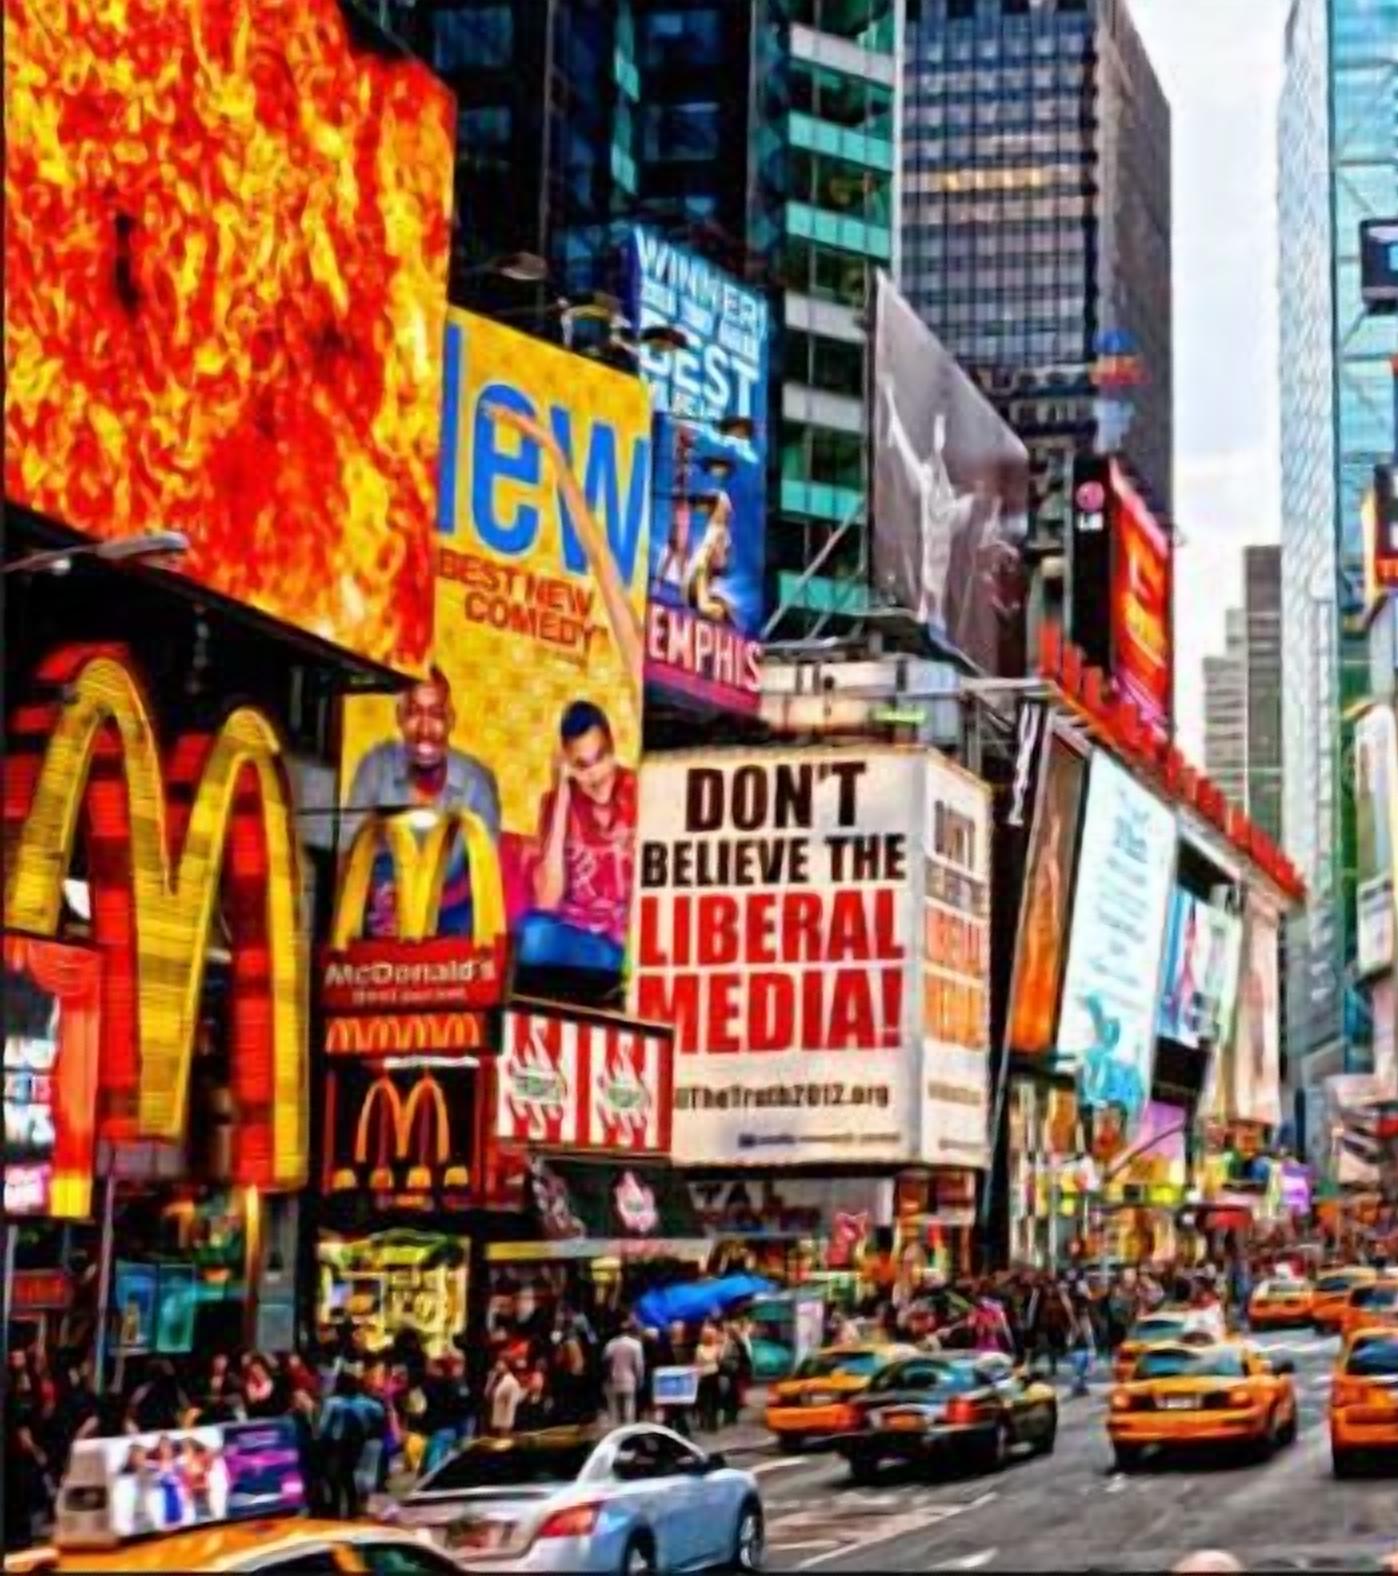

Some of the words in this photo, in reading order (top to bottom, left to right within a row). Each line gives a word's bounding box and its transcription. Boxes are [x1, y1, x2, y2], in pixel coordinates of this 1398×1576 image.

[439, 546, 520, 594] BEST
[524, 571, 595, 617] NEW
[684, 762, 867, 832] DON'T
[640, 836, 809, 888] BELIEVE
[825, 833, 907, 881] THE
[638, 889, 906, 967] LIBERAL
[324, 961, 496, 987] McDonald's
[638, 967, 902, 1054] MEDIA!
